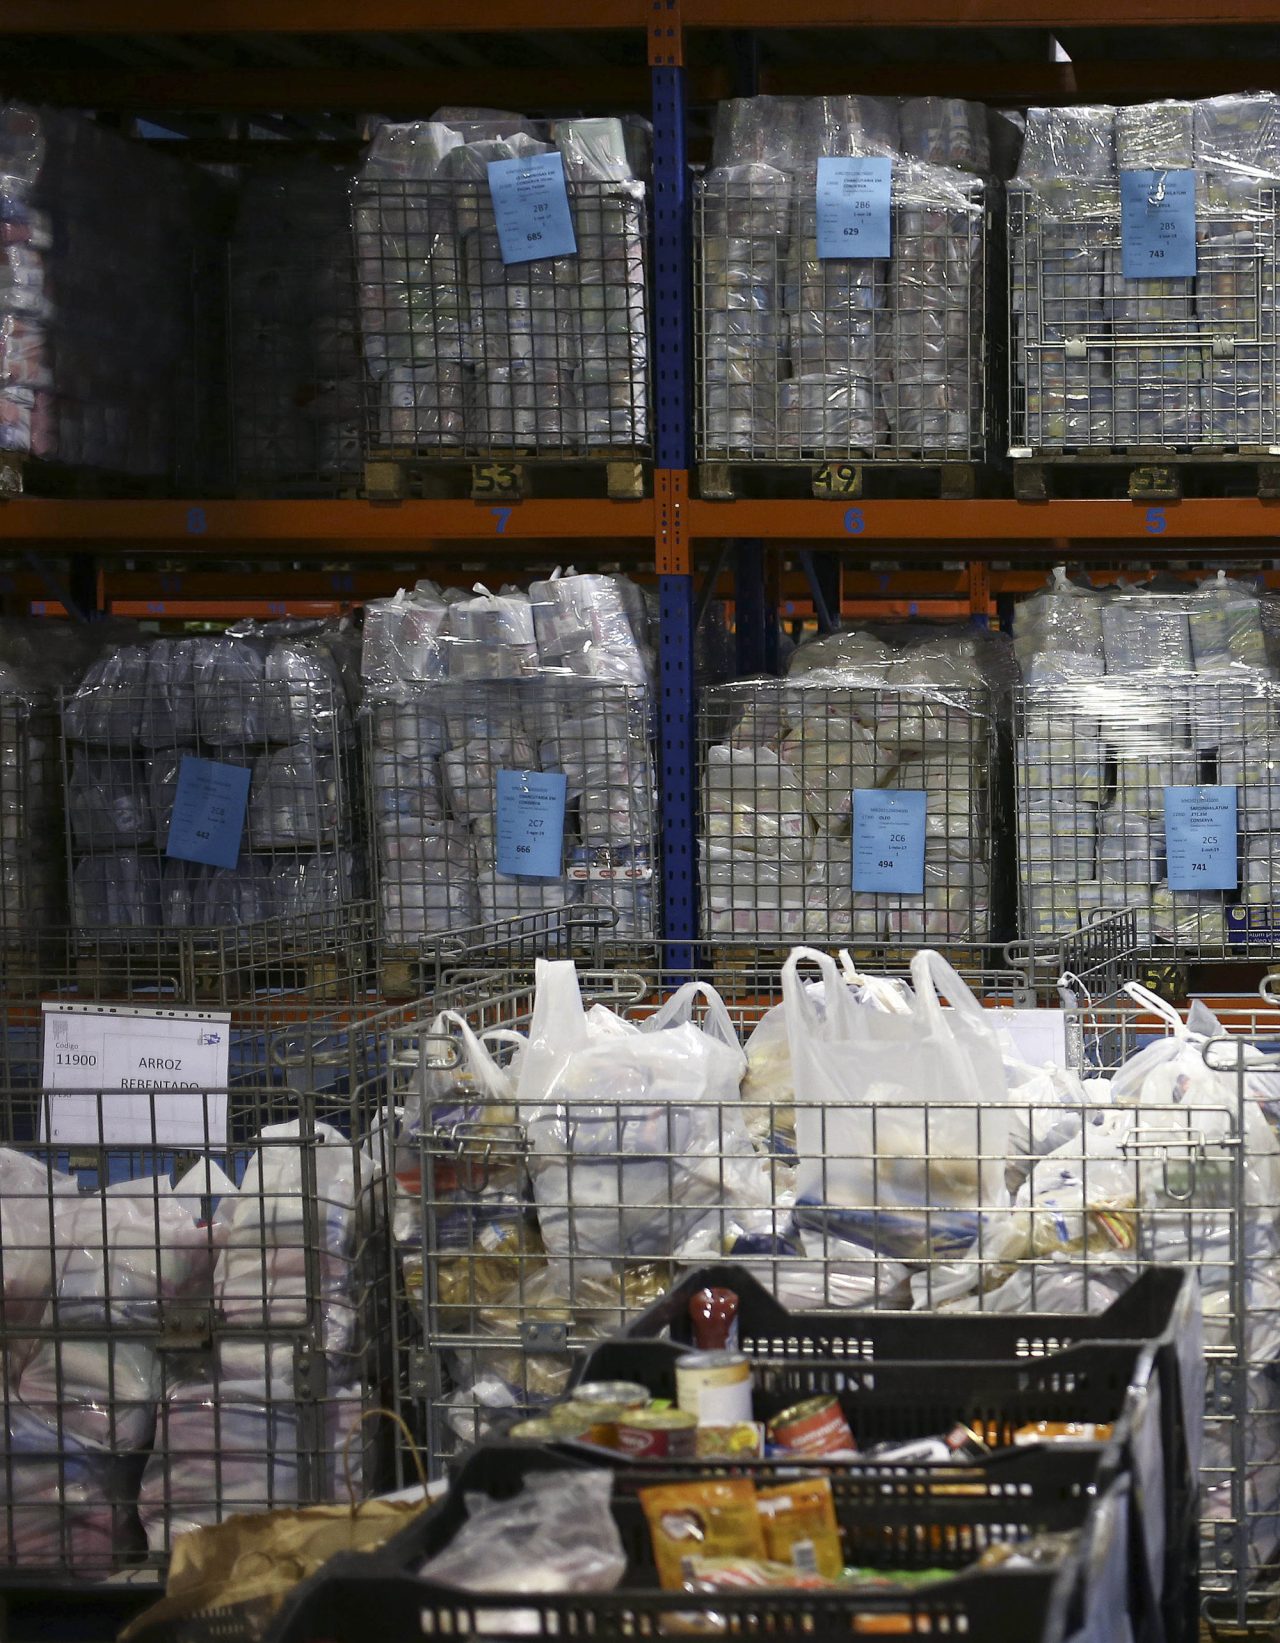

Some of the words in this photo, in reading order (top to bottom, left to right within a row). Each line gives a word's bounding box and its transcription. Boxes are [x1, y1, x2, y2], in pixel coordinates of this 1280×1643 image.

[843, 227, 859, 236] 629
[527, 232, 542, 241] 685
[1149, 250, 1165, 258] 743
[815, 462, 856, 492] 49
[490, 507, 513, 534] 7
[844, 506, 865, 534] 6
[1145, 506, 1168, 534] 5
[528, 819, 544, 828] 2C7
[890, 834, 906, 843] 2C6
[1202, 836, 1218, 844] 2C5
[516, 845, 531, 853] 666
[878, 860, 893, 868] 494
[1191, 863, 1207, 871] 741
[55, 1042, 79, 1050] Código
[55, 1053, 97, 1067] 11900
[138, 1057, 182, 1071] ARROZ
